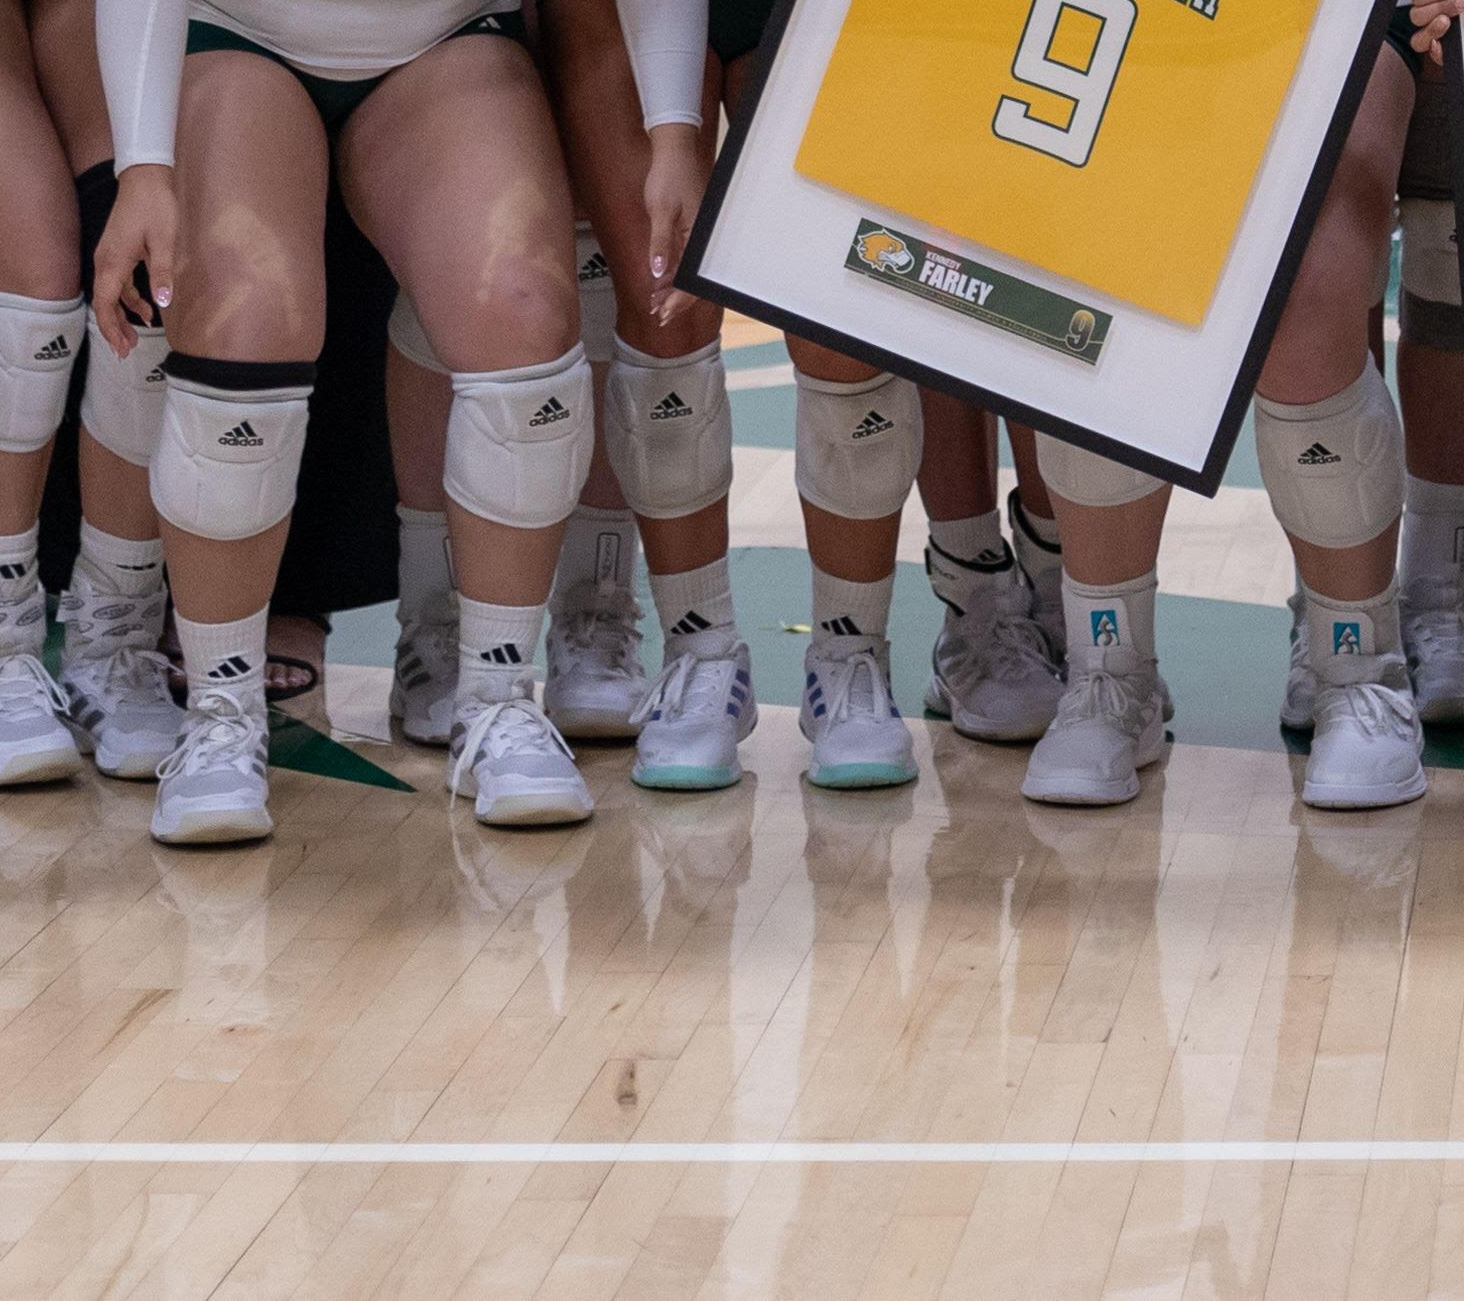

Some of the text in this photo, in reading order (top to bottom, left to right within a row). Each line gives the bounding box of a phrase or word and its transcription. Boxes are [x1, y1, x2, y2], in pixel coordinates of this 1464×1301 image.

[920, 260, 994, 306] FARLEY
[1066, 309, 1096, 352] 9
[529, 409, 570, 427] adidas
[650, 408, 693, 420] adidas
[852, 421, 894, 438] adidas
[218, 437, 264, 447] adidas
[1298, 455, 1341, 465] adidas
